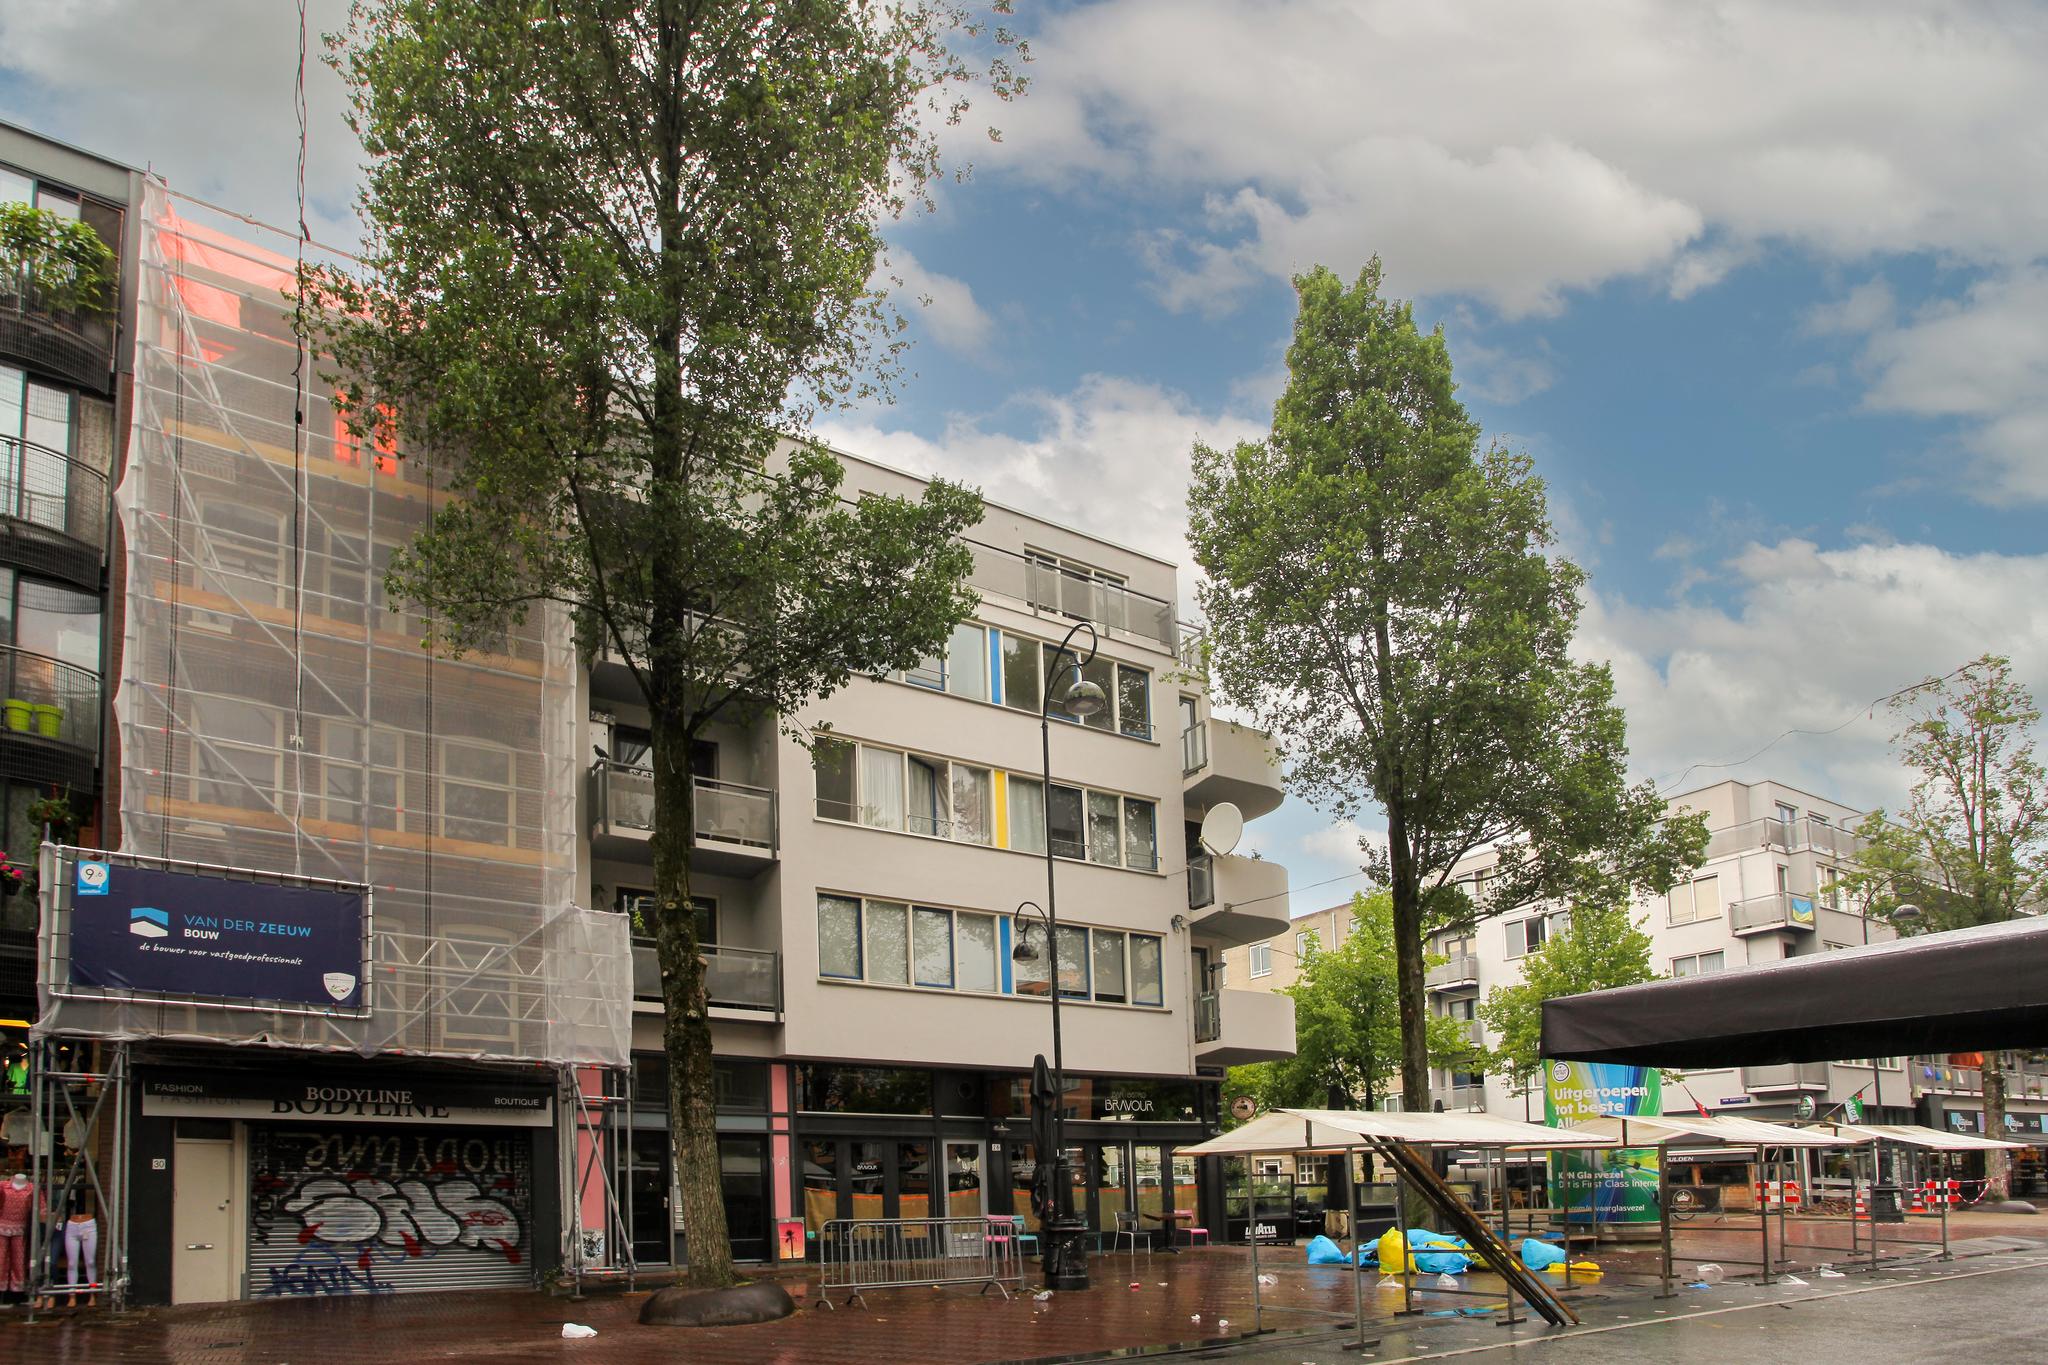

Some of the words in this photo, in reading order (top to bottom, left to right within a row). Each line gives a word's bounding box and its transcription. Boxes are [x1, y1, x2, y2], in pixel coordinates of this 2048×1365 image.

[184, 914, 218, 929] VAN
[223, 918, 254, 932] DER
[258, 922, 312, 938] ZEEUW
[184, 928, 220, 940] BOUW
[139, 942, 151, 951] de
[153, 943, 186, 954] bouwer
[188, 949, 208, 957] voor
[210, 951, 303, 966] vastgoedprofessionals
[154, 1083, 204, 1094] FASHION
[306, 1087, 413, 1104] BODYLINE
[1554, 1086, 1648, 1101] Uitgeroepen
[494, 1097, 540, 1106] BOUTIQUE
[1104, 1098, 1155, 1112] BRAVOUR
[1555, 1103, 1574, 1115] tot
[1577, 1101, 1625, 1114] beste
[153, 1160, 165, 1169] 30
[1572, 1180, 1579, 1188] is
[1605, 1179, 1629, 1188] Class
[1244, 1222, 1277, 1236] LAZZA
